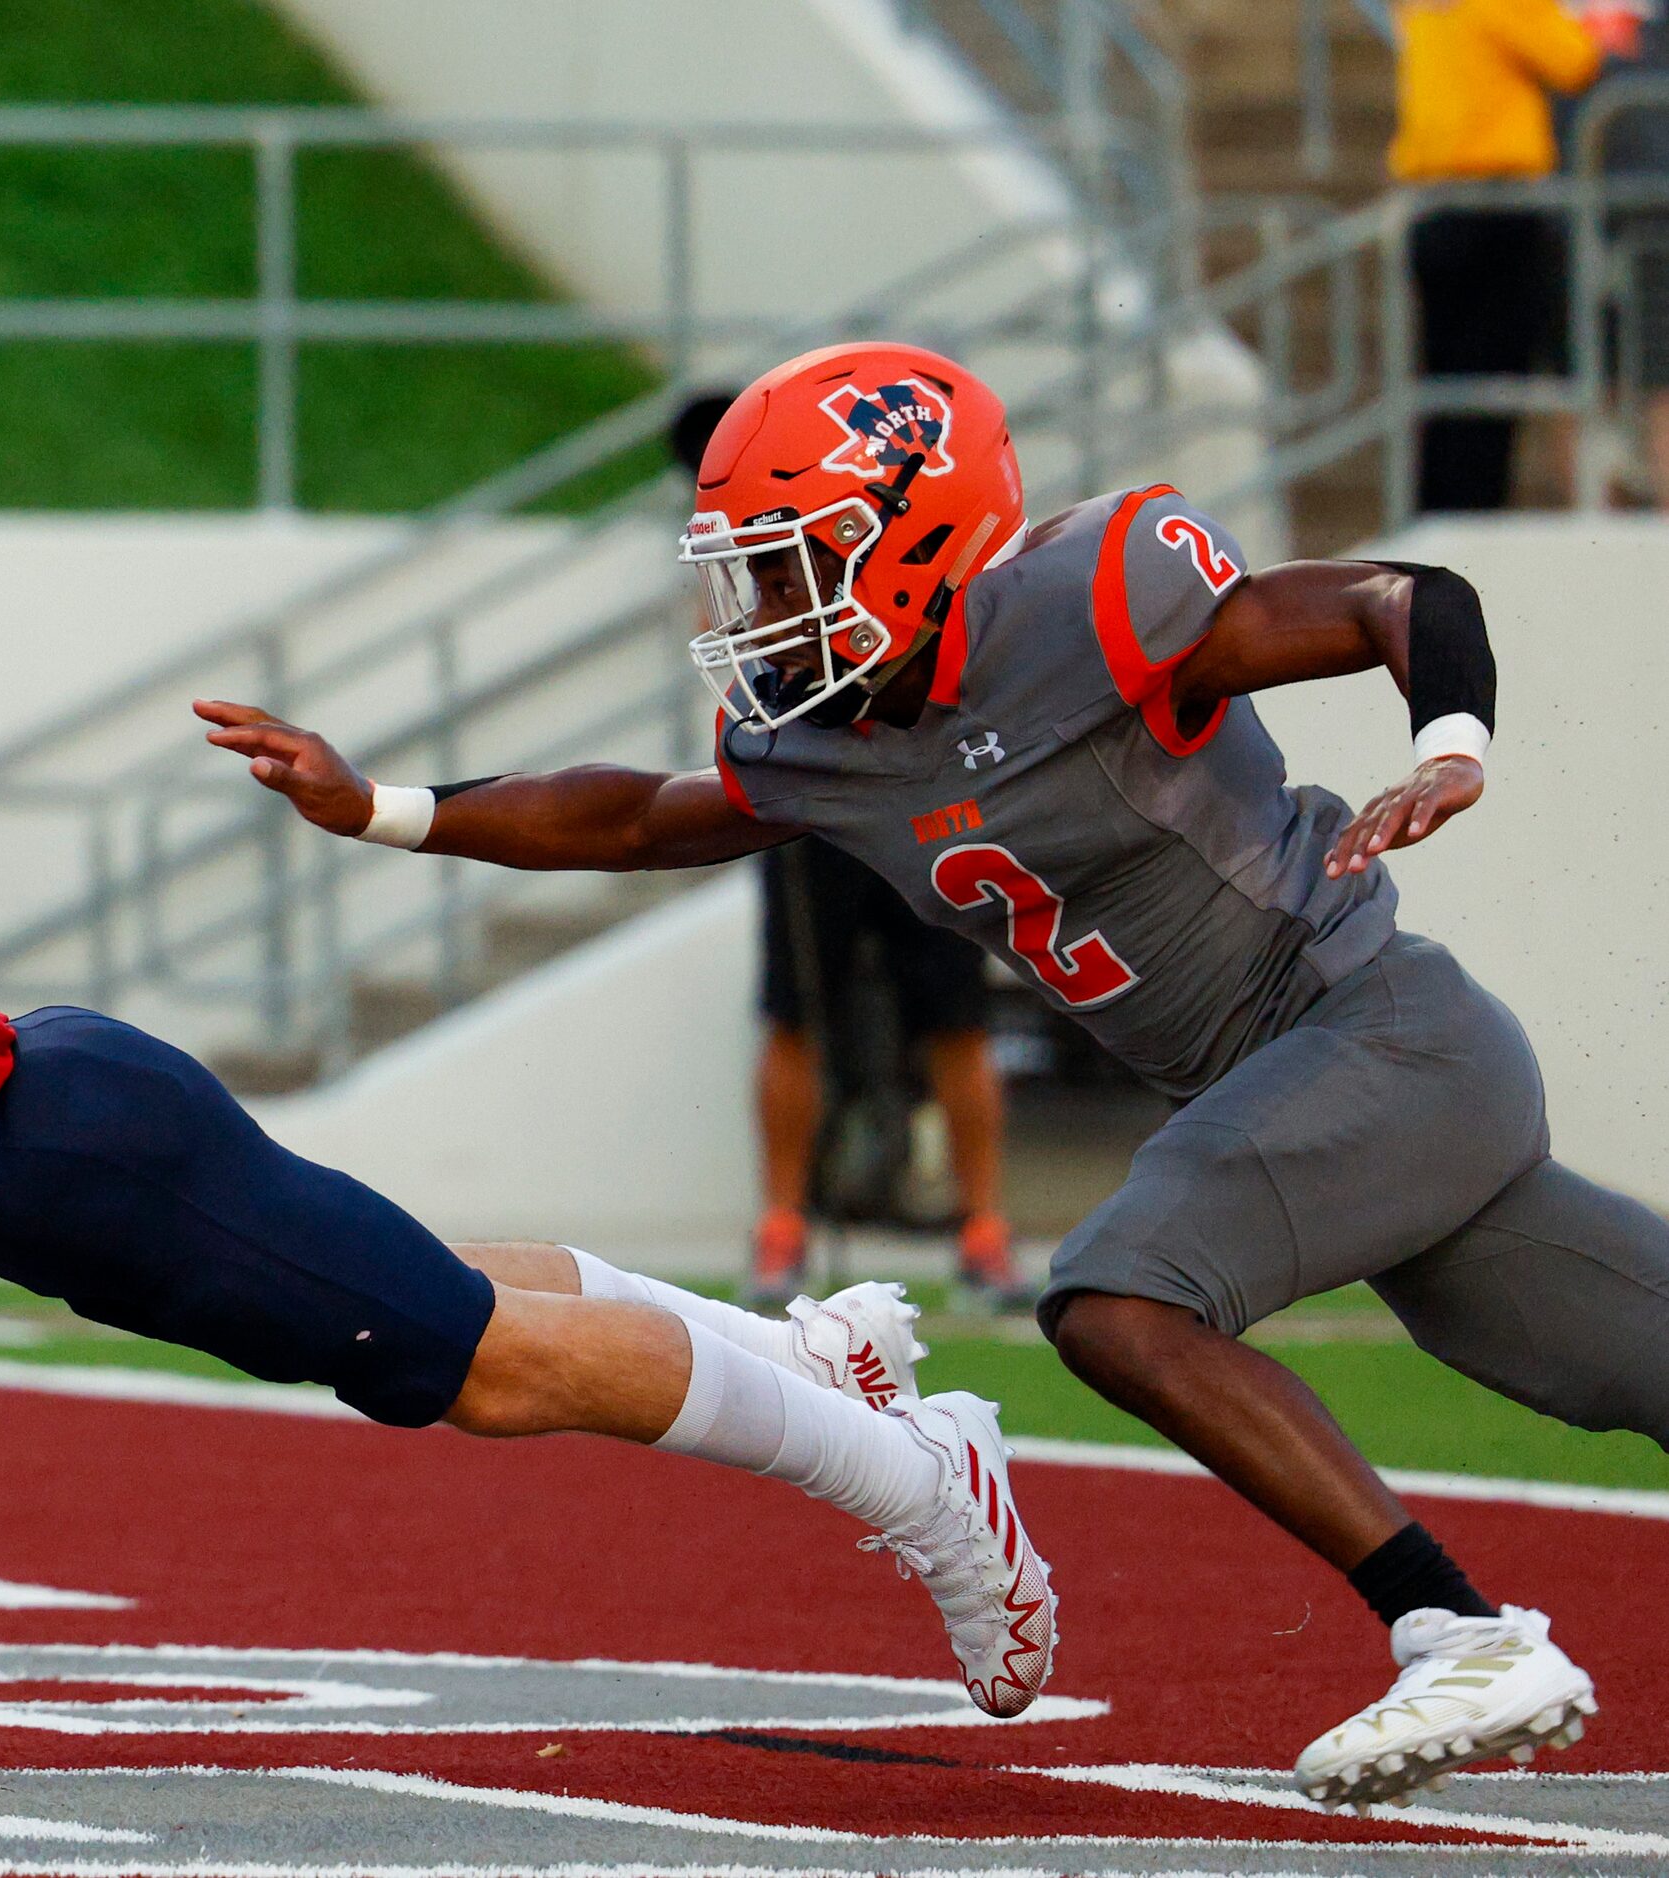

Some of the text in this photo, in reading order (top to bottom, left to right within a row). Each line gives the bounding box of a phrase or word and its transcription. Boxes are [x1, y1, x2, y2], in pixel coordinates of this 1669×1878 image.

[864, 404, 932, 457] NORTH
[752, 511, 782, 527] schutt
[1155, 514, 1243, 596] 2
[931, 843, 1141, 1006] 2
